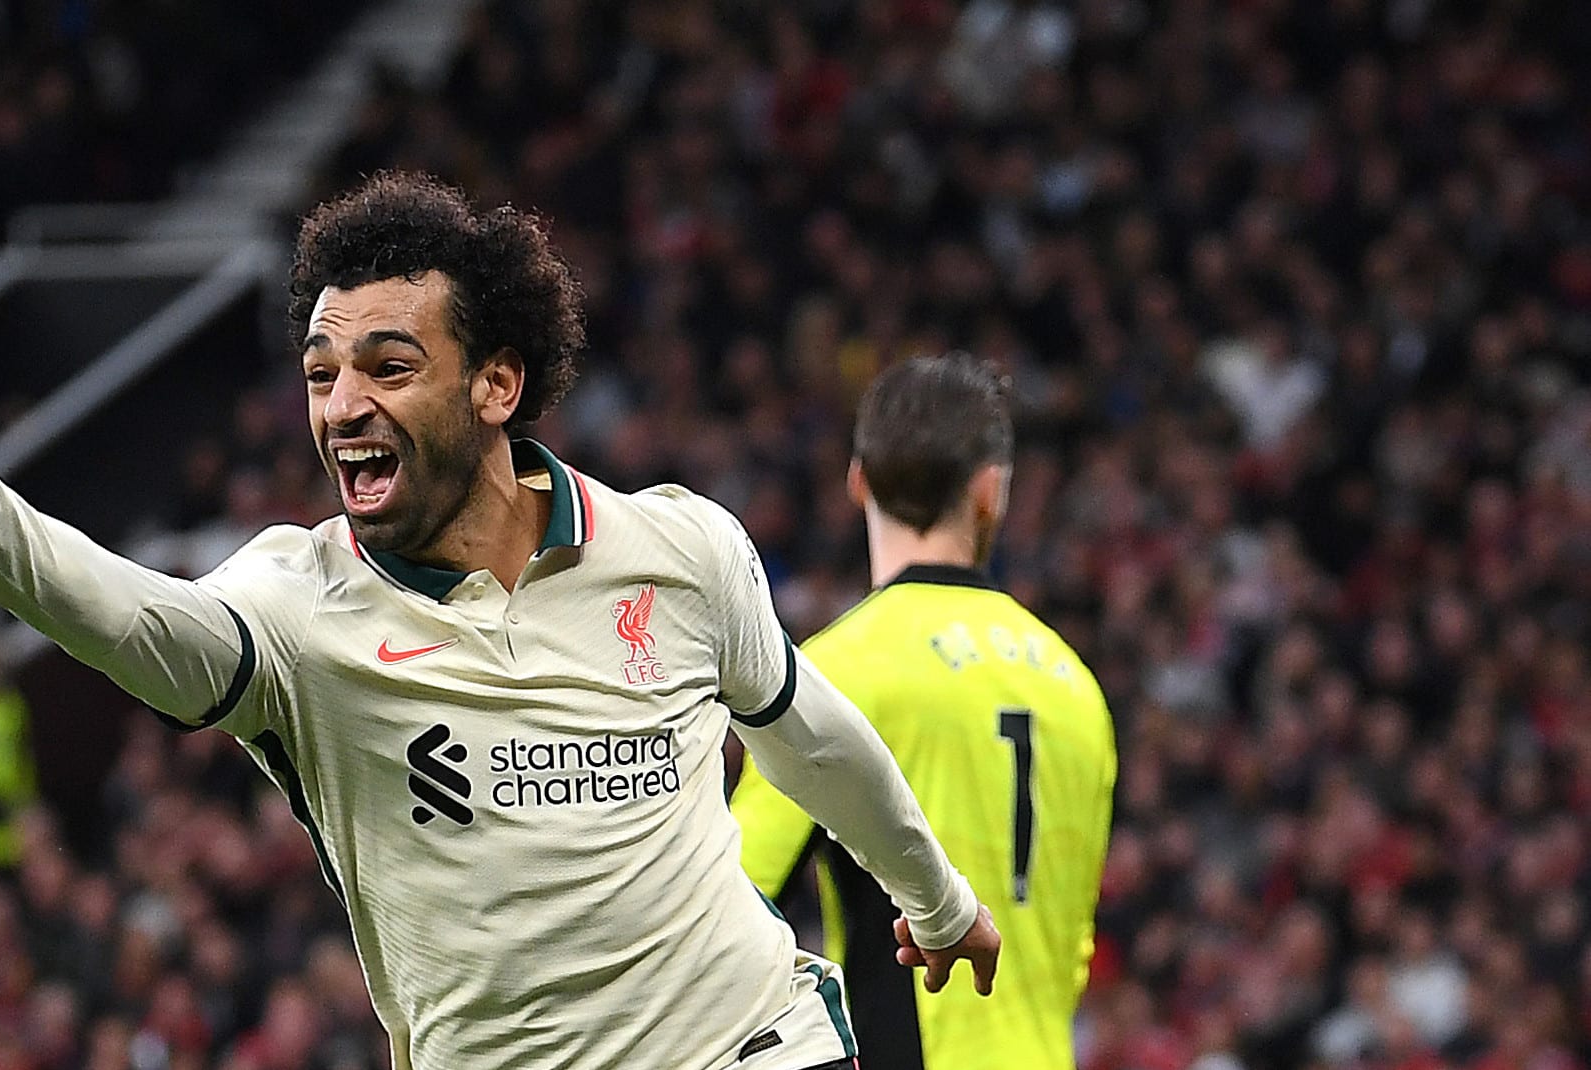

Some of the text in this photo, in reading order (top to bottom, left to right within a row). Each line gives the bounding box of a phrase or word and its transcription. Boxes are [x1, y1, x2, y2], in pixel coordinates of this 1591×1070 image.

[490, 728, 674, 772] standard
[492, 758, 680, 807] chartered
[1000, 711, 1033, 903] 1
